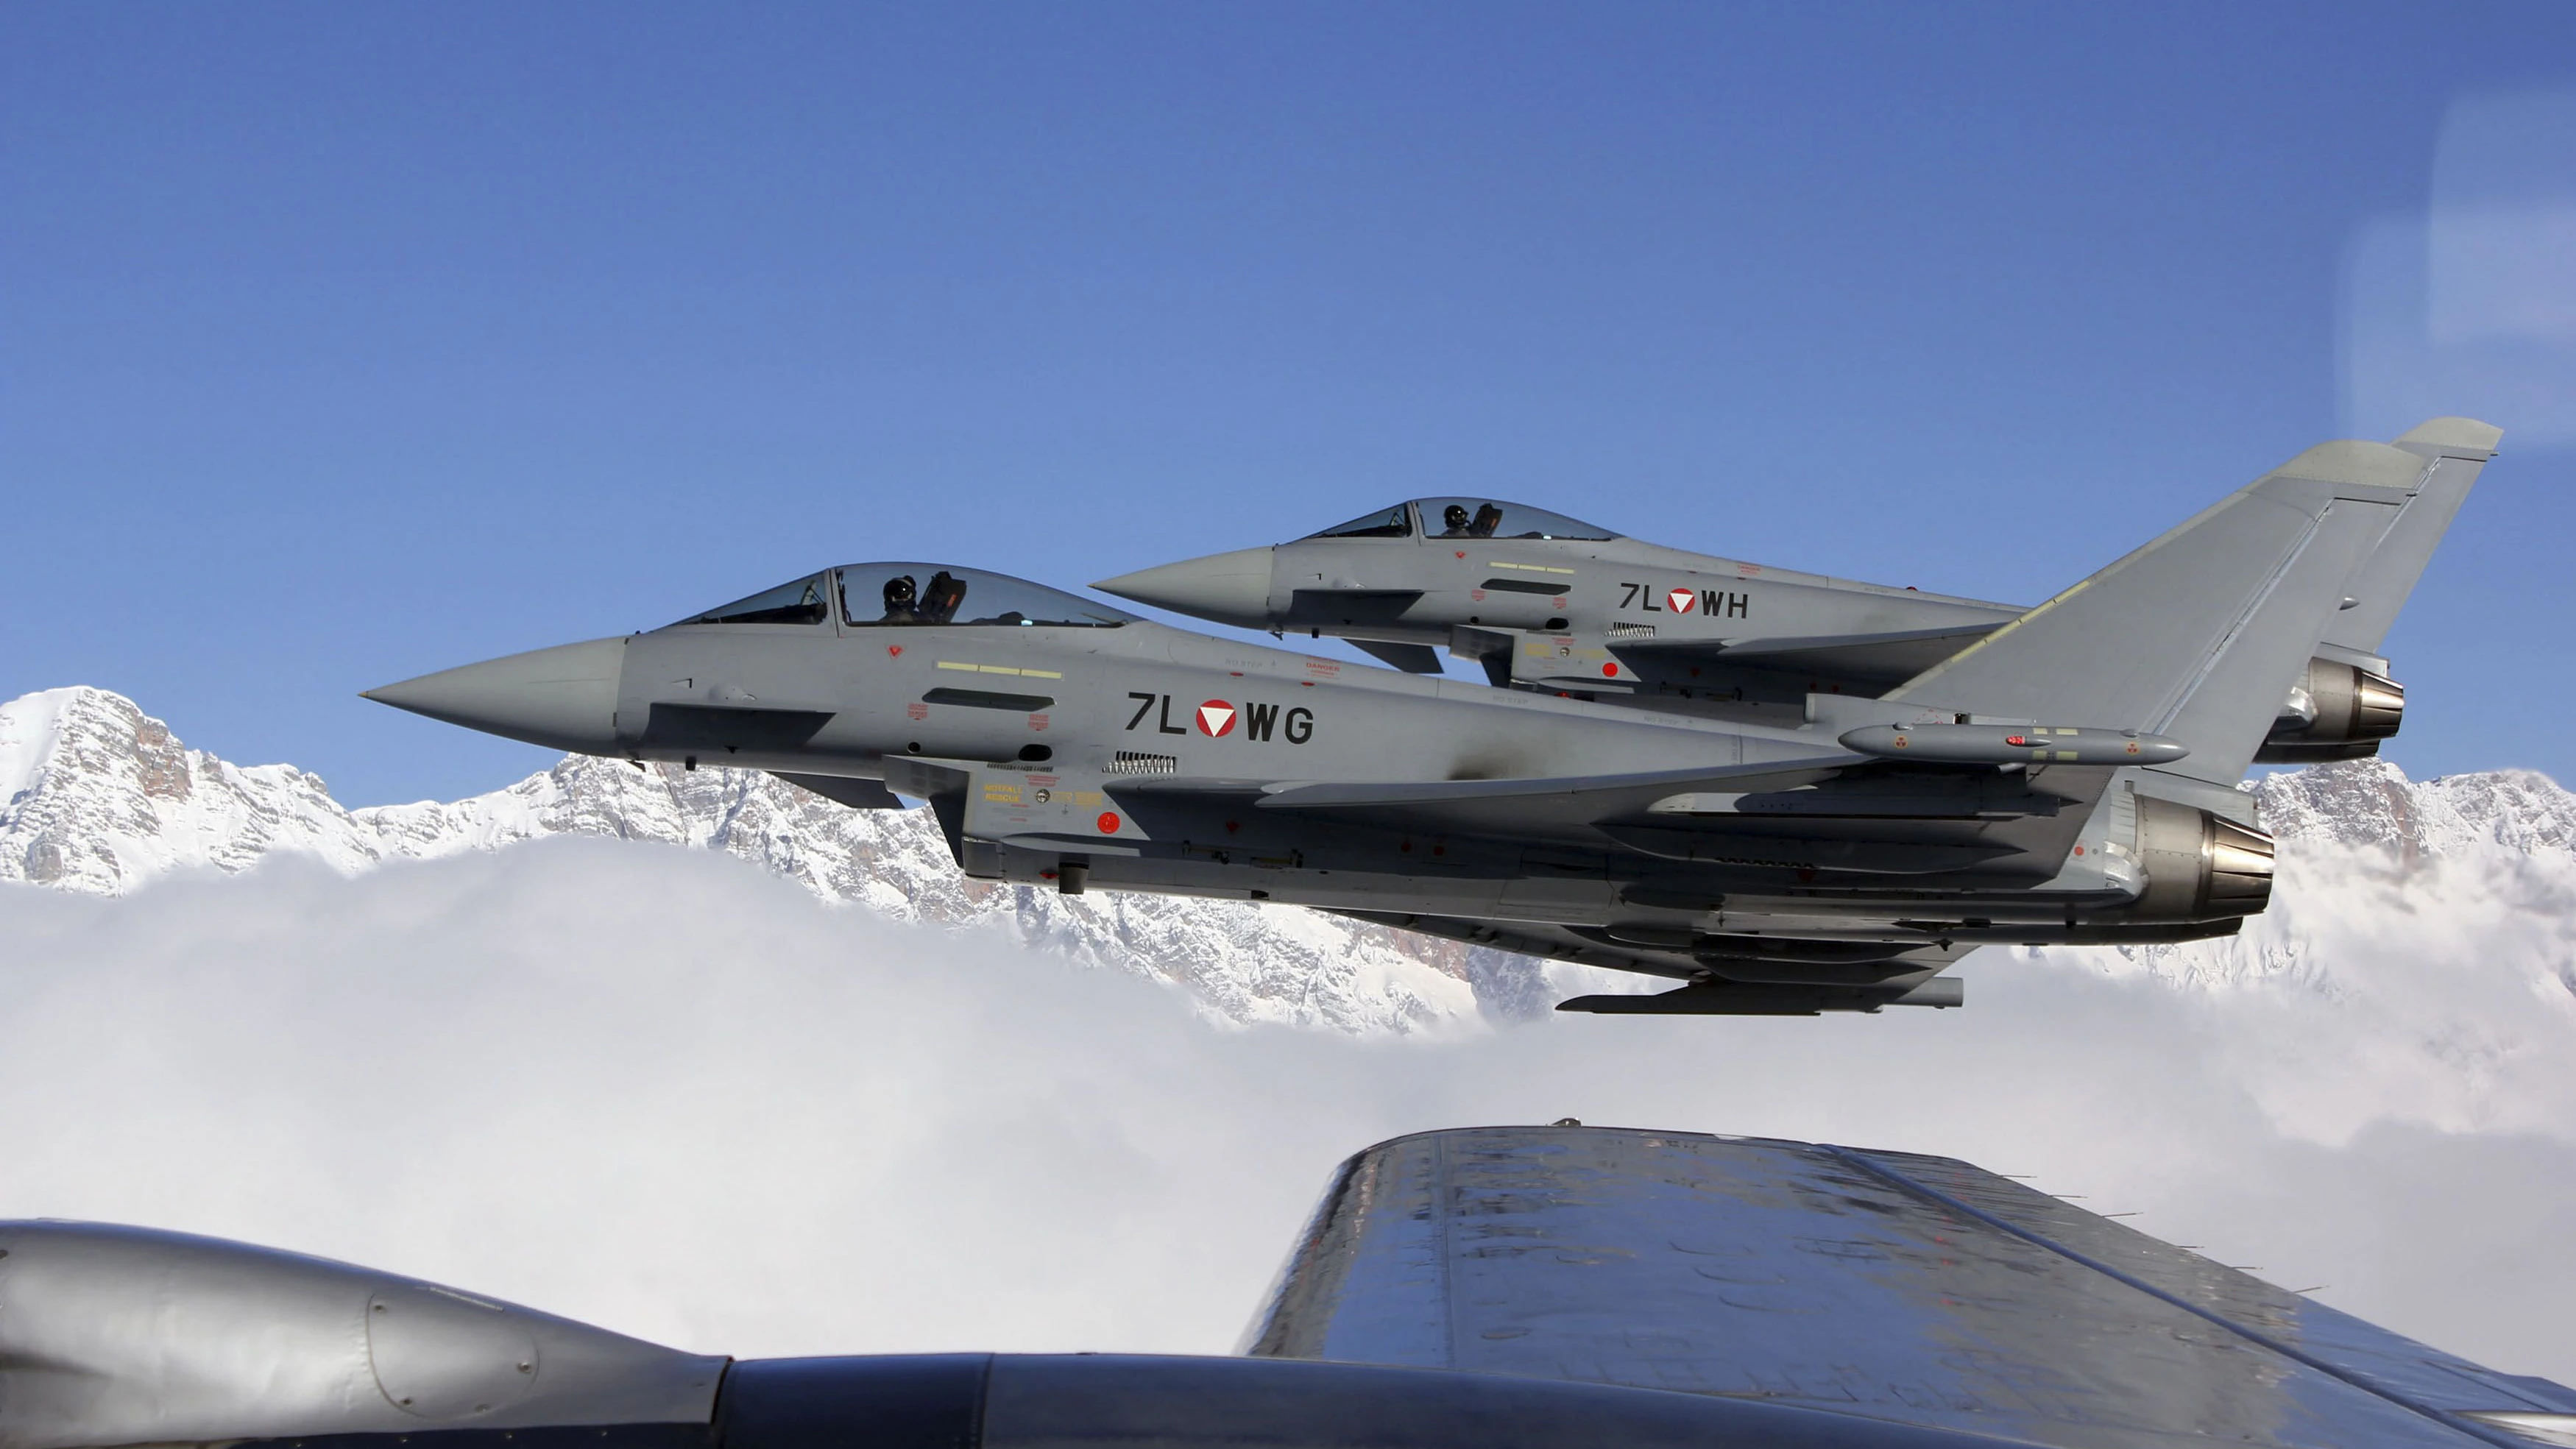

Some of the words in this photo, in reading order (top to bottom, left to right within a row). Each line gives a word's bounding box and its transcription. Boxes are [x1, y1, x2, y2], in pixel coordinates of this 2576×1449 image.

[1619, 583, 1662, 612] 7L
[1701, 589, 1748, 619] WH
[1306, 662, 1341, 672] DANGER
[1125, 692, 1186, 735] 7L
[1246, 702, 1314, 745] WG
[985, 793, 1021, 803] RESCUE
